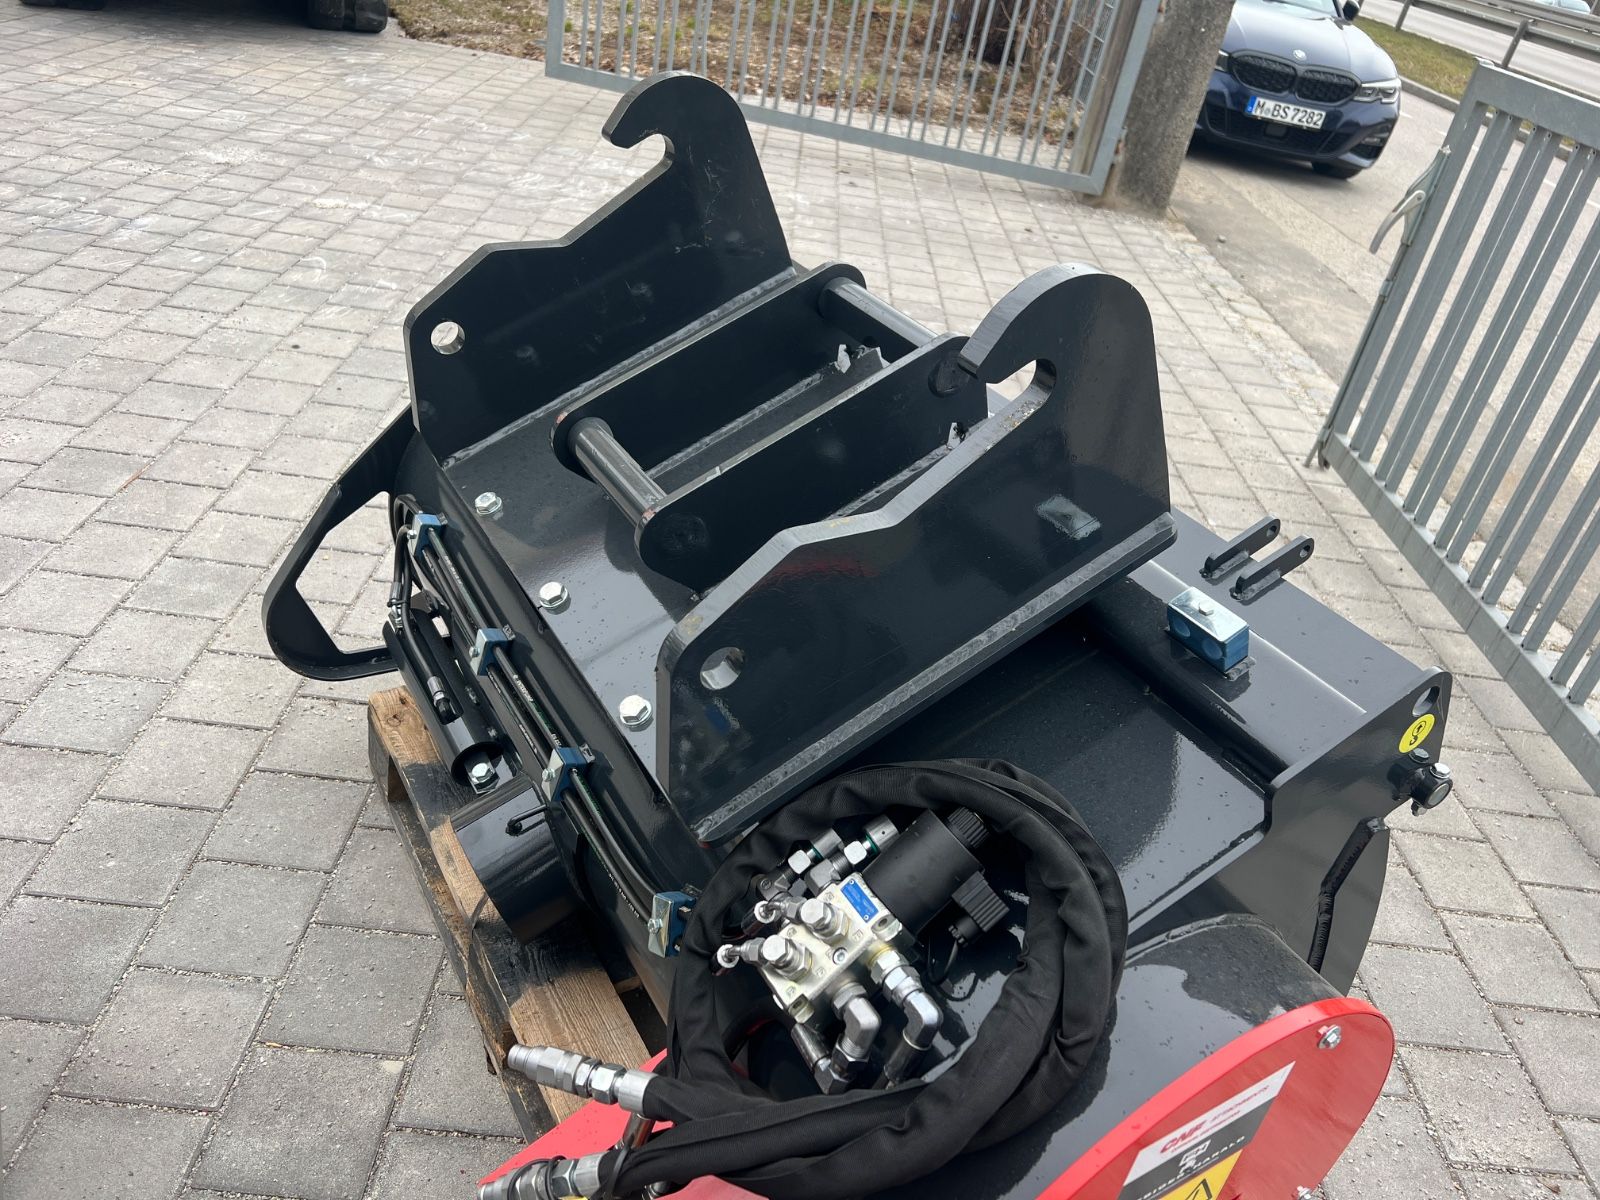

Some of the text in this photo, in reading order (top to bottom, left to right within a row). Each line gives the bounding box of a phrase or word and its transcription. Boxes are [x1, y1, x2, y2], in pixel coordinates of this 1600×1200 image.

[1255, 100, 1323, 126] M BS 7282
